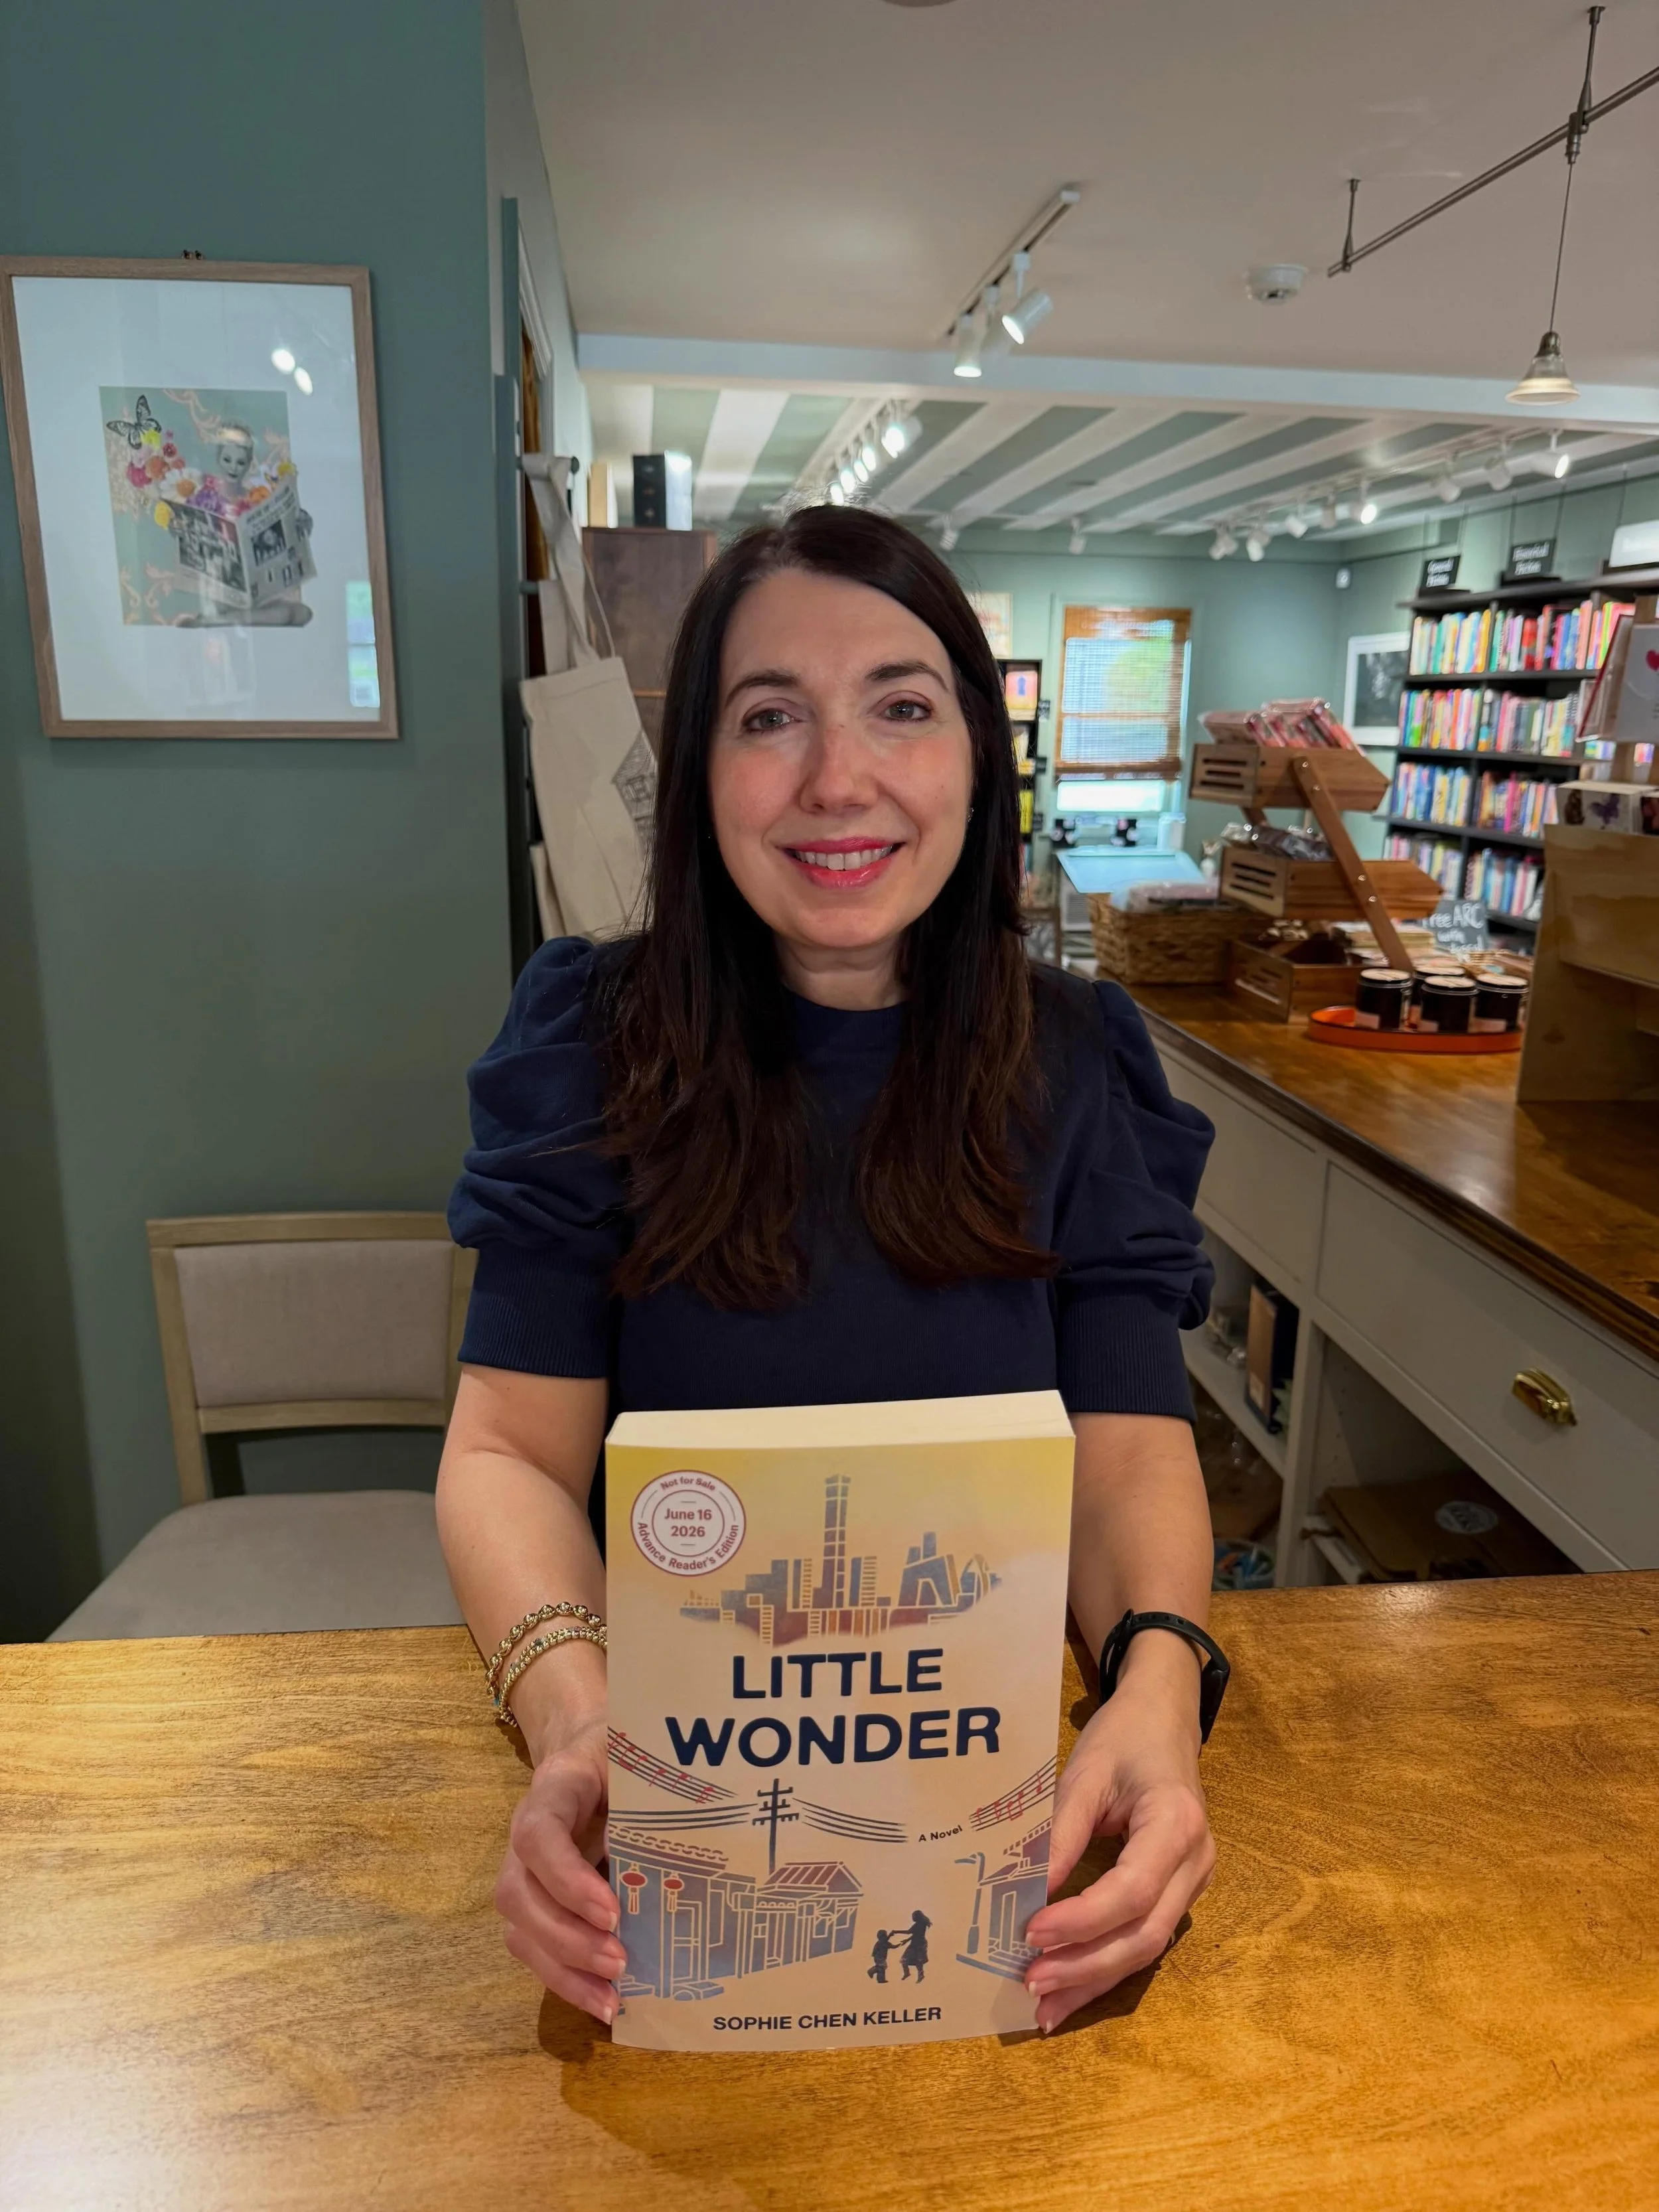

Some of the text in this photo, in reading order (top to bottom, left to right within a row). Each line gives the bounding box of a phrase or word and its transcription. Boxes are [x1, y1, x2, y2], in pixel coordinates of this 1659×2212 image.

[1453, 903, 1484, 928] ARC
[660, 1476, 716, 1491] Not for Sale
[664, 1508, 713, 1520] June 16
[671, 1526, 705, 1537] 2026
[638, 1522, 739, 1570] Advance Reader's Edition
[733, 1648, 943, 1699] LITTLE
[665, 1706, 1001, 1767] WONDER
[918, 1824, 963, 1842] A Novel
[713, 2006, 942, 2030] SOPHIE CHEN KELLER
